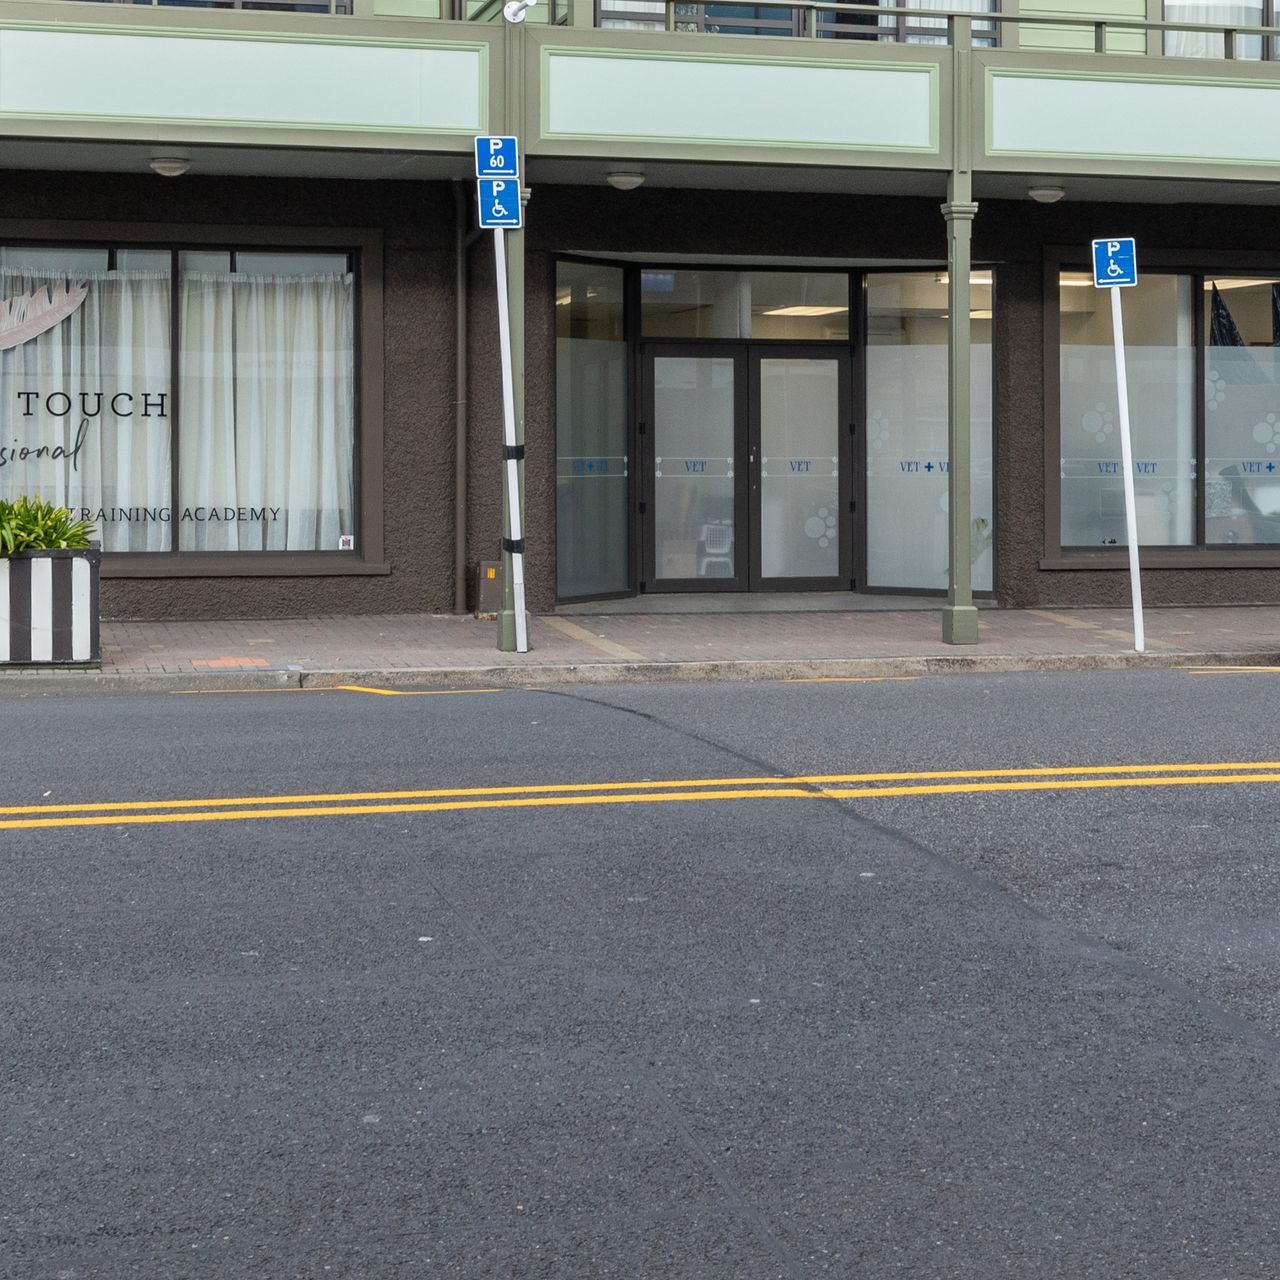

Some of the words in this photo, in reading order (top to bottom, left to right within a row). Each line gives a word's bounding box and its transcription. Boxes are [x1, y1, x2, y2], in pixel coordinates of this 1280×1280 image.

[489, 139, 503, 155] P
[489, 155, 505, 168] 60
[492, 181, 506, 197] P
[1107, 241, 1120, 257] P
[17, 391, 169, 418] TOUCH
[684, 460, 707, 472] VET
[789, 460, 812, 472] VET
[900, 461, 921, 473] VET
[1097, 462, 1119, 473] VET
[1136, 462, 1158, 473] VET
[1242, 461, 1263, 473] VET
[181, 506, 281, 521] ACADEMY
